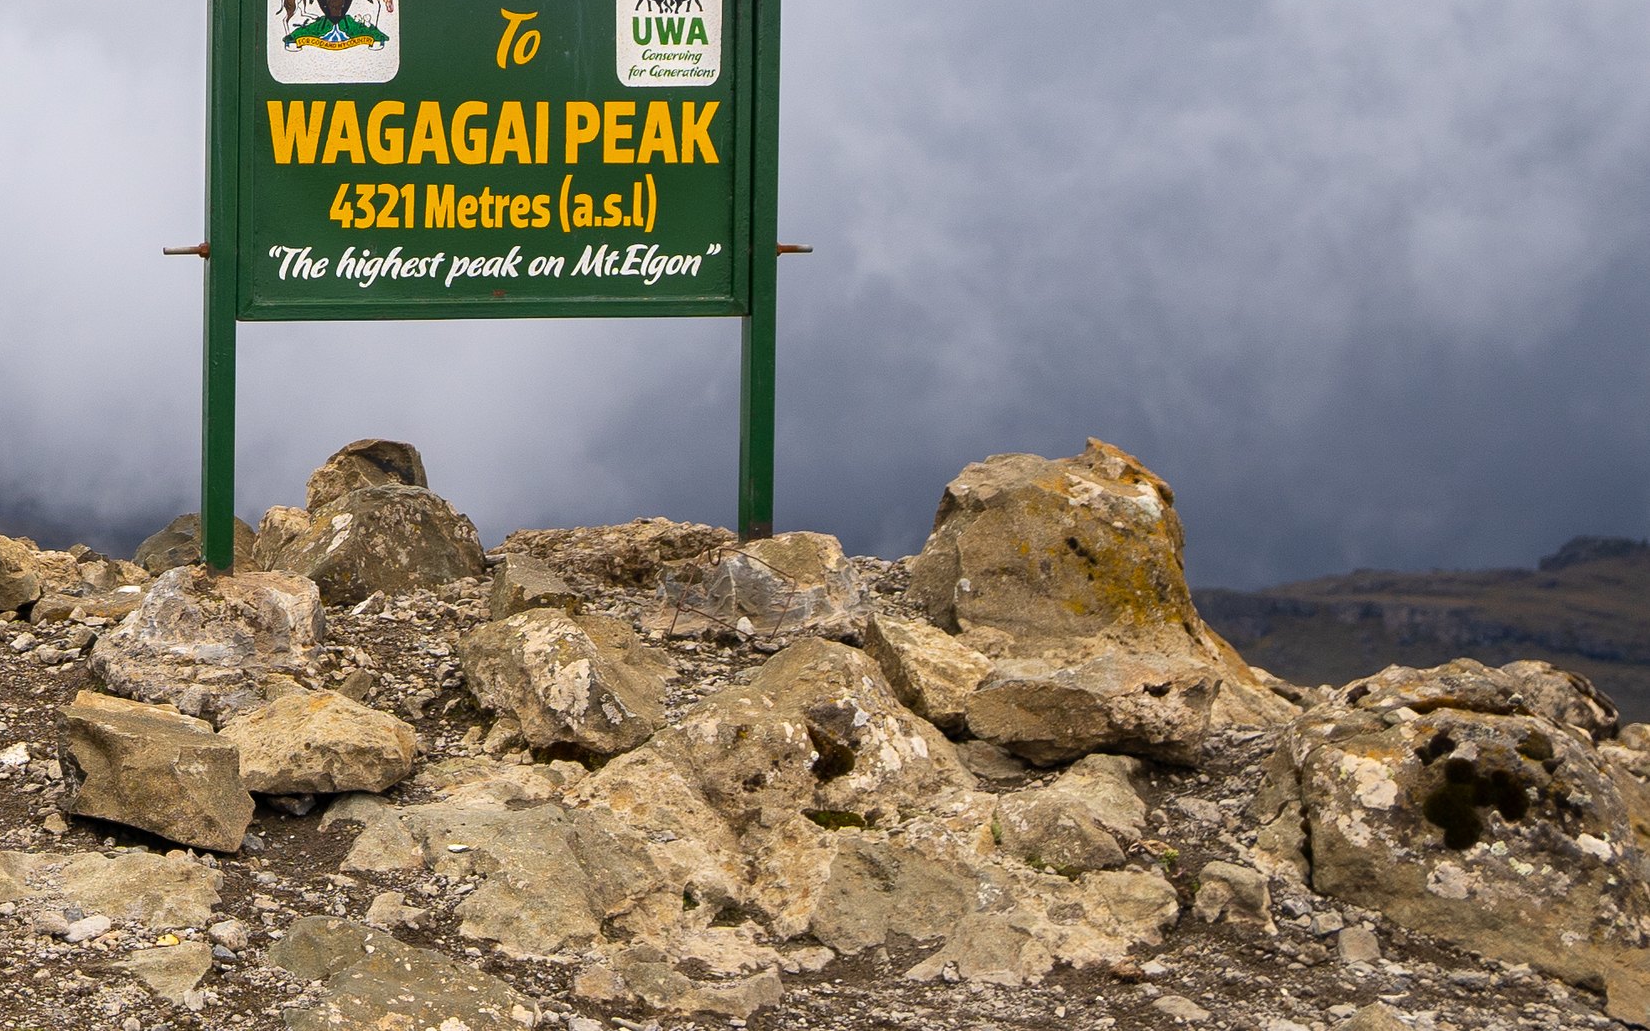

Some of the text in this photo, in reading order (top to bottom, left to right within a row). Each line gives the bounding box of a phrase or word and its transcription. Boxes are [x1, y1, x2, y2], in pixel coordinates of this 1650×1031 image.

[496, 7, 541, 69] To
[632, 16, 709, 46] UWA
[628, 65, 716, 80] for Generations
[641, 49, 703, 64] Conserving
[267, 100, 721, 165] WAGAGAI PEAK
[329, 174, 658, 233] 4321 Metres (a.s.l)
[335, 245, 446, 287] highest
[444, 245, 523, 287] peak
[528, 254, 563, 278] on
